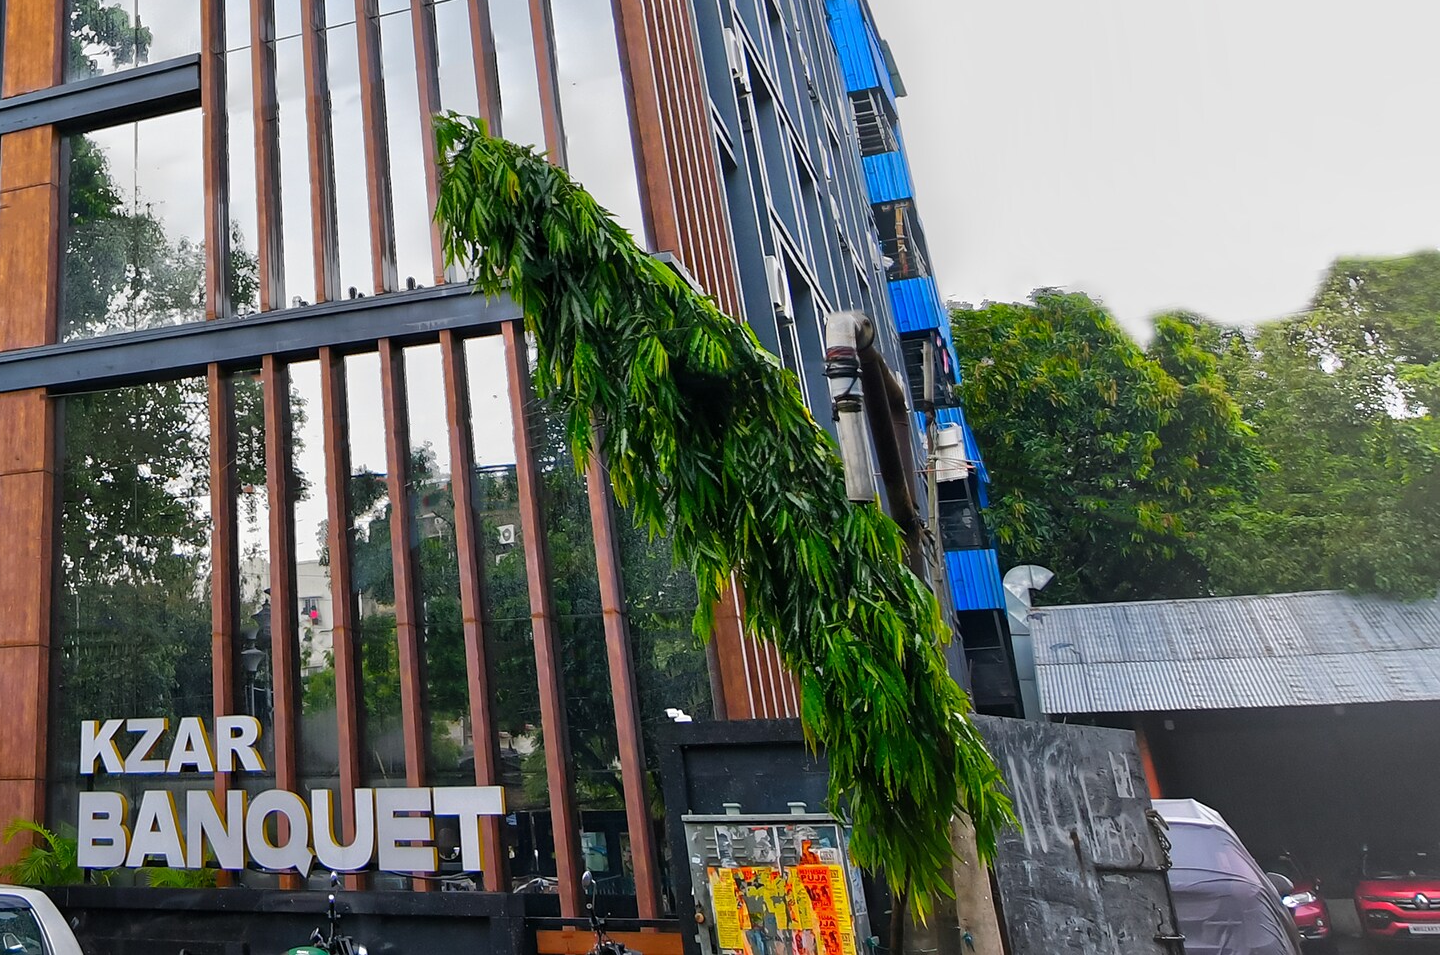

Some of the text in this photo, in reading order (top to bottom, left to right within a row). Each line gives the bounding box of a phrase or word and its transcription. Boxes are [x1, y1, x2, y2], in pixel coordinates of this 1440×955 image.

[79, 715, 266, 776] KZAR
[76, 785, 506, 880] BANQUET
[801, 874, 828, 884] PUJA
